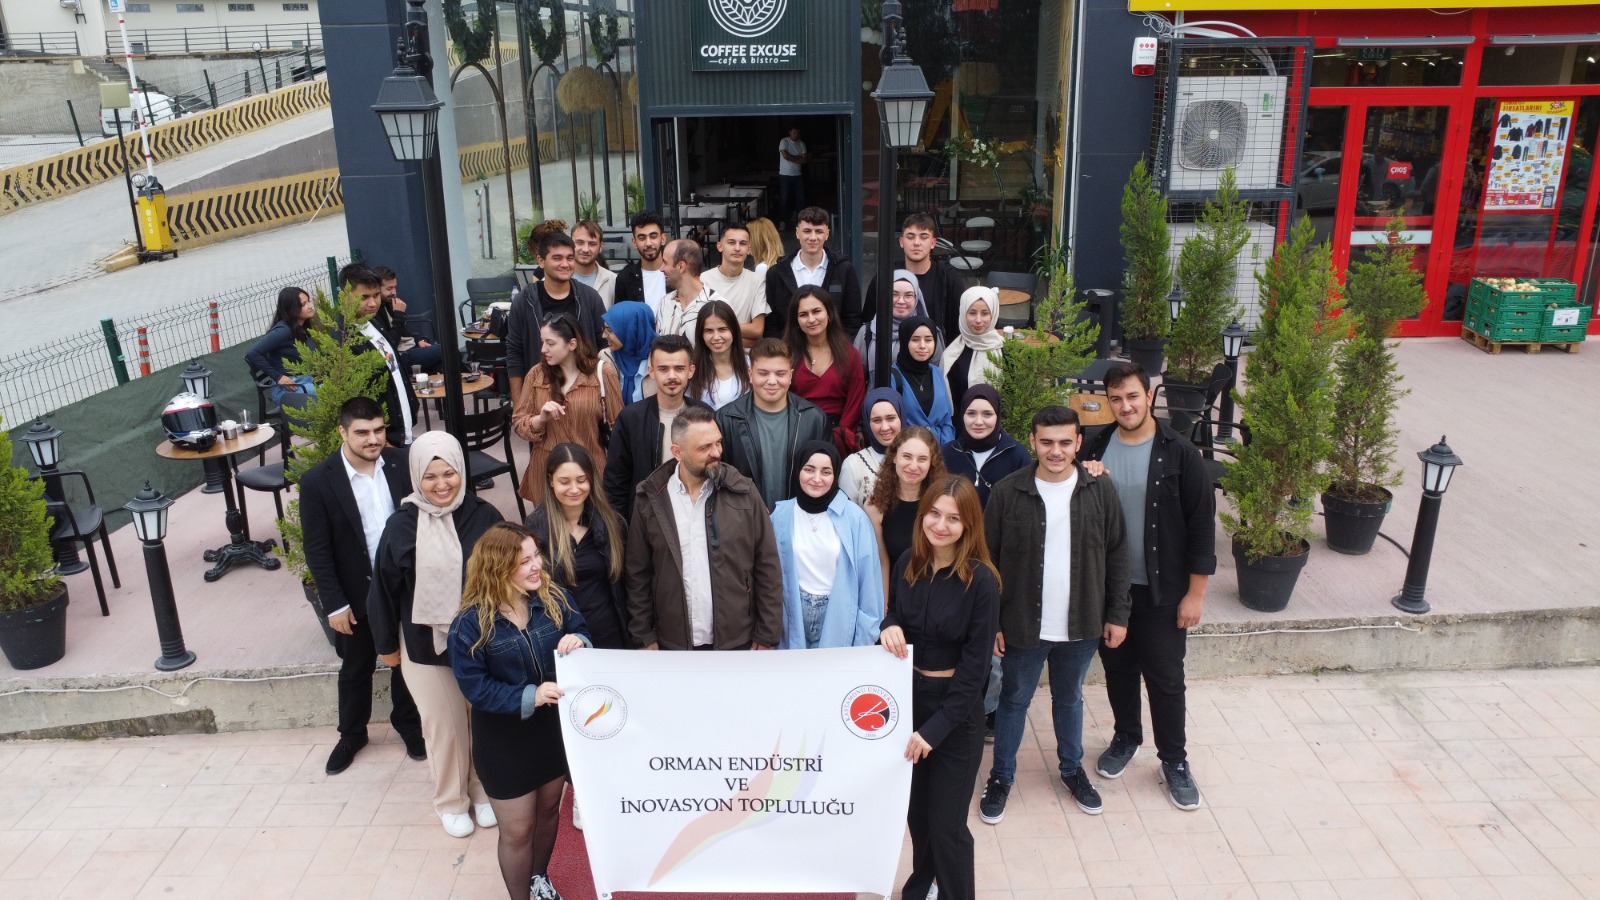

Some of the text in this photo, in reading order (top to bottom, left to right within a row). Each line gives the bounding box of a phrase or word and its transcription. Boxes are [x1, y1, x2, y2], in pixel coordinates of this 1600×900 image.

[701, 44, 797, 57] COFFEE EXCUSE
[718, 57, 737, 65] cafe
[1390, 166, 1407, 175] ÇIKIŞ
[844, 688, 866, 722] KASTAMONU
[649, 754, 823, 772] ORMAN ENDÜSTRİ
[724, 778, 749, 791] VE
[620, 797, 854, 816] İNOVASYON TOPLULUĞU
